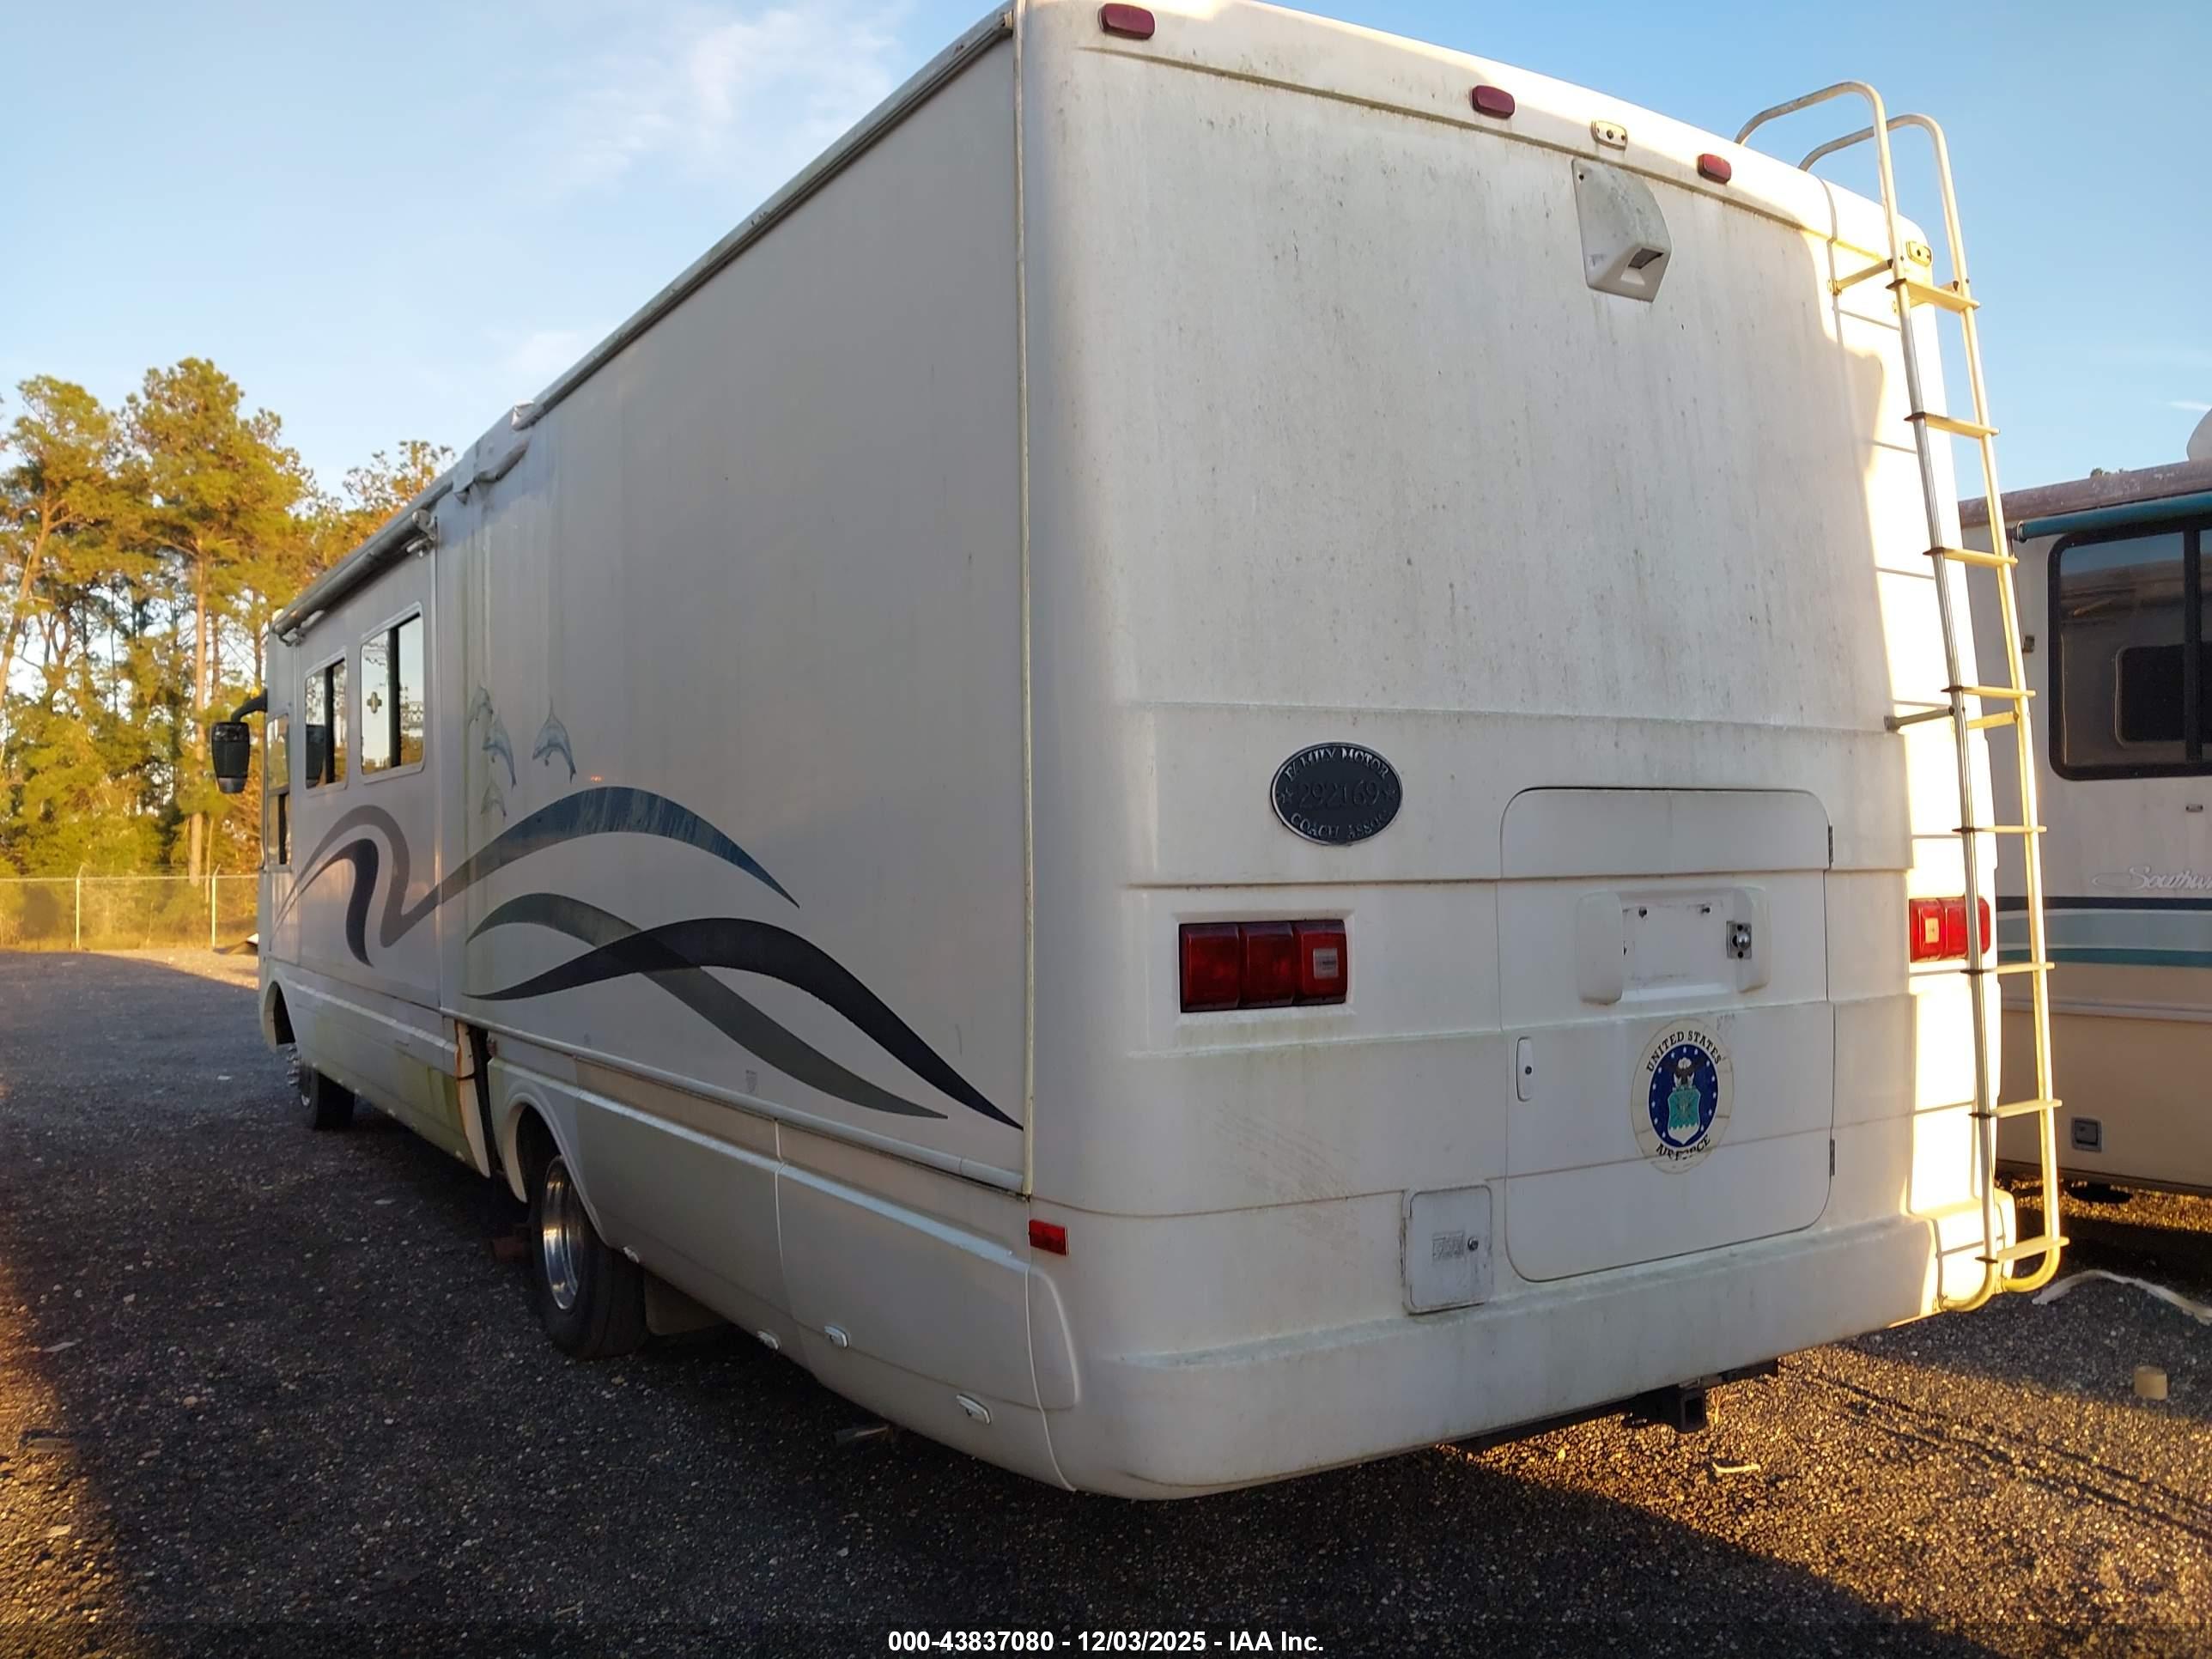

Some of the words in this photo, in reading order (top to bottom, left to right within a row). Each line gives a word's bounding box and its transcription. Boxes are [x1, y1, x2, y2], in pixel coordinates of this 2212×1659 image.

[1341, 747, 1389, 780] MOTOR
[1298, 780, 1382, 810] 292169
[1291, 812, 1340, 838] COACH
[1646, 1031, 1684, 1072] UNITED
[1687, 1030, 1721, 1064] STATES
